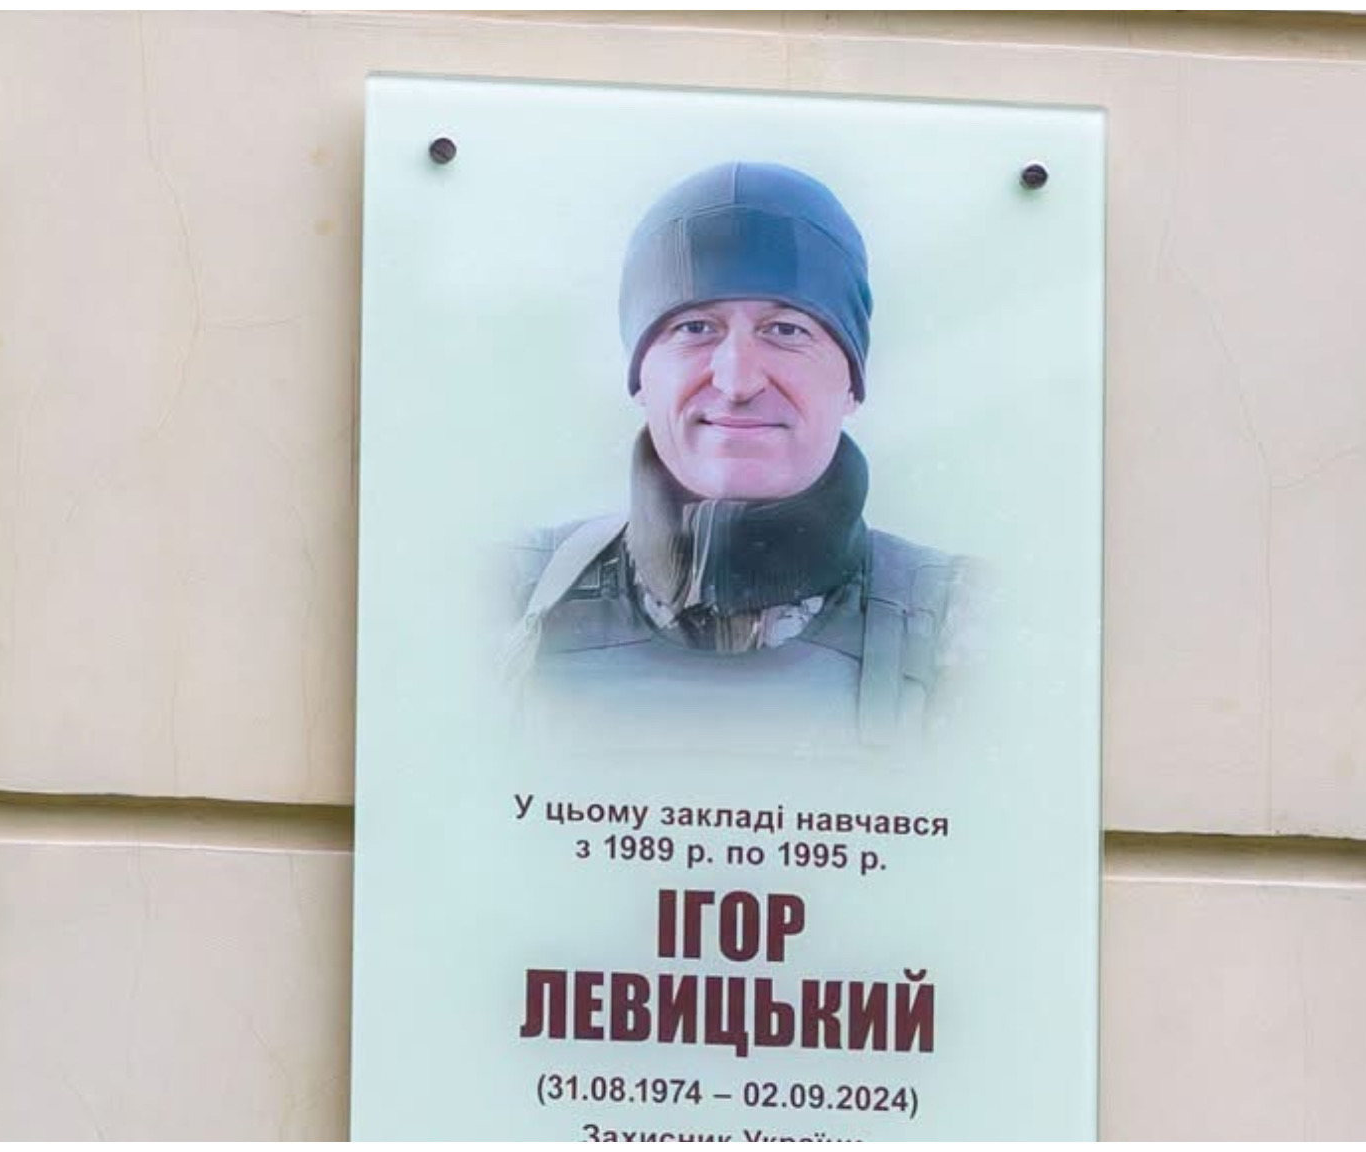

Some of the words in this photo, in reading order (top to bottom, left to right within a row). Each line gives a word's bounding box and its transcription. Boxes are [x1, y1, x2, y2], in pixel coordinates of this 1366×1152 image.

[514, 793, 534, 820] У
[546, 801, 649, 831] цьому
[660, 804, 784, 833] закладі
[796, 811, 949, 837] навчався
[575, 839, 591, 859] з
[604, 834, 675, 862] 1989
[687, 843, 714, 869] р.
[727, 845, 765, 866] по
[778, 841, 848, 869] 1995
[860, 851, 887, 876] р.
[657, 888, 806, 963] ІГОР
[519, 968, 935, 1058] ЛЕВИЦЬКИЙ
[537, 1073, 703, 1106] (31.08.1974
[743, 1081, 919, 1119] 02.09.2024)
